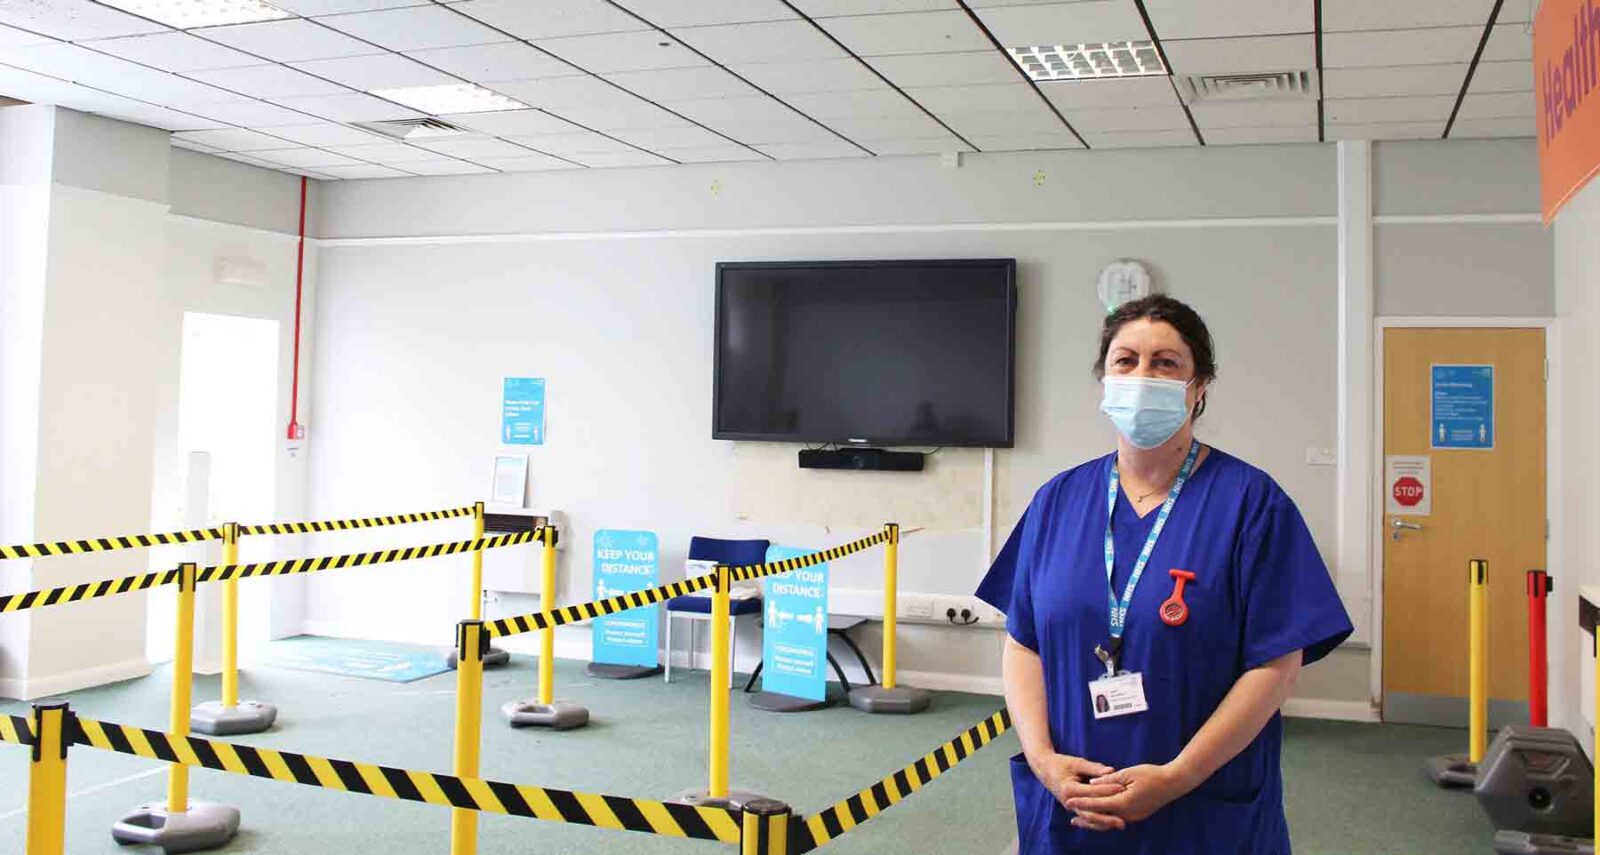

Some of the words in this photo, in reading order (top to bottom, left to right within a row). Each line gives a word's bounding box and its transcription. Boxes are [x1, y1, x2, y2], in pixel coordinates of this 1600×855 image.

[1394, 486, 1422, 497] STOP
[1122, 583, 1134, 601] NHS
[1132, 561, 1147, 577] NHS
[1142, 540, 1156, 555] NHS
[1152, 518, 1166, 533] NHS
[1163, 498, 1176, 512] NHS
[1173, 477, 1184, 492] NHS
[598, 550, 623, 560] KEEP
[624, 550, 654, 562] YOUR
[601, 563, 652, 575] DISTANCE
[795, 570, 824, 583] YOUR
[772, 582, 822, 598] DISTANCE
[1110, 607, 1119, 627] NHS
